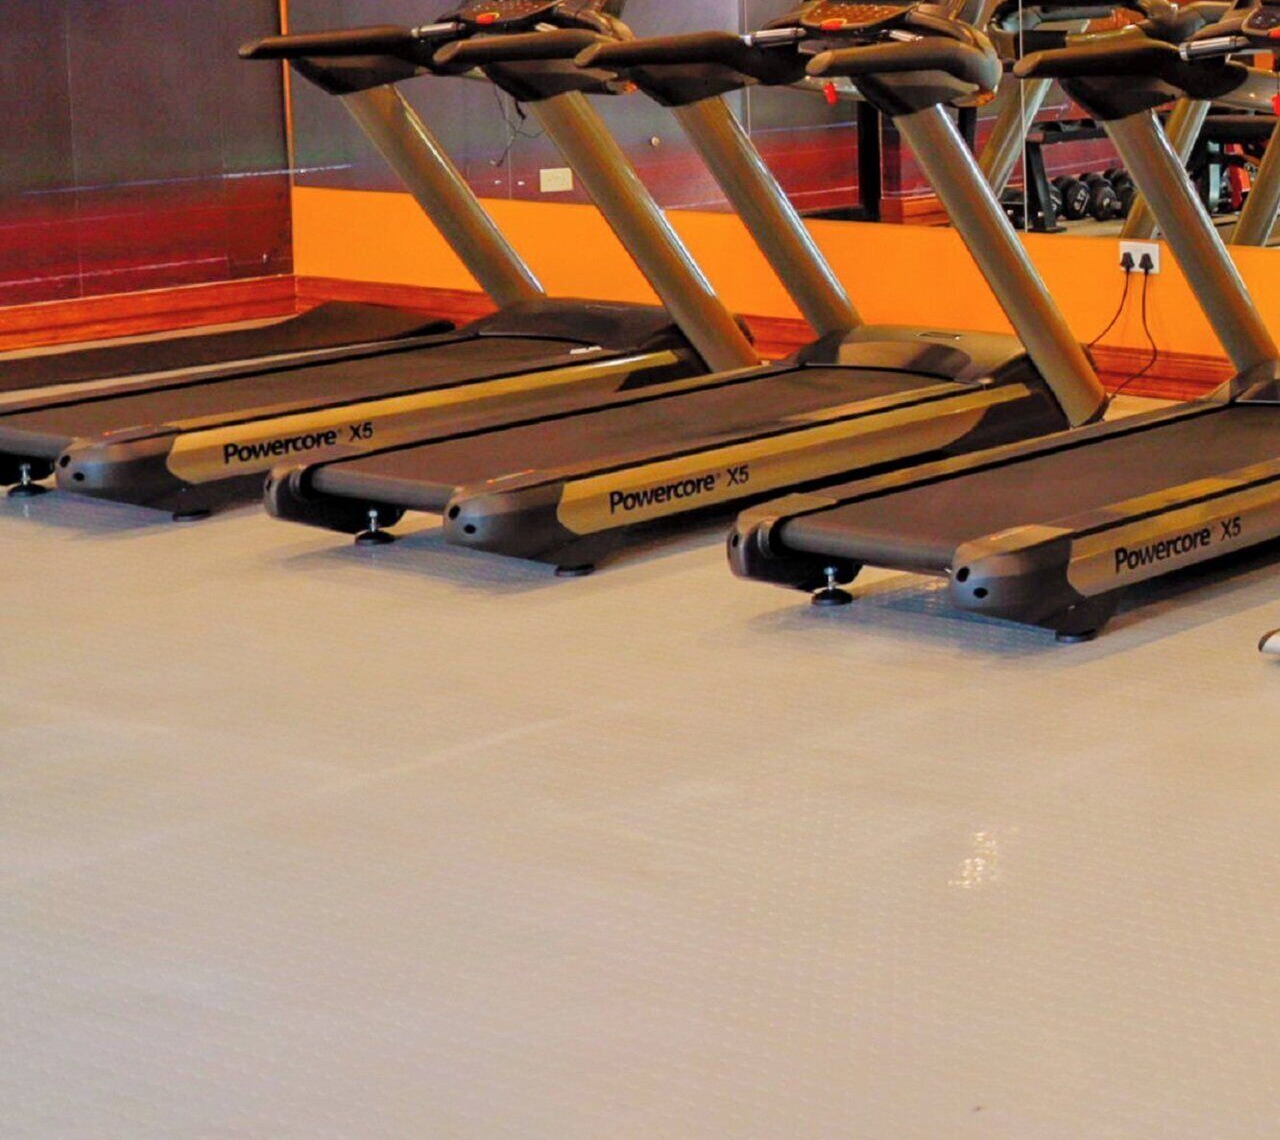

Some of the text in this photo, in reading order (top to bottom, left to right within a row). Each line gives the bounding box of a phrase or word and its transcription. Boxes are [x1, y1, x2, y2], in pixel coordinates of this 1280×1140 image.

[223, 422, 373, 464] Powercore X5
[609, 464, 749, 514] Powercore X5
[1114, 516, 1242, 574] Powercore X5
